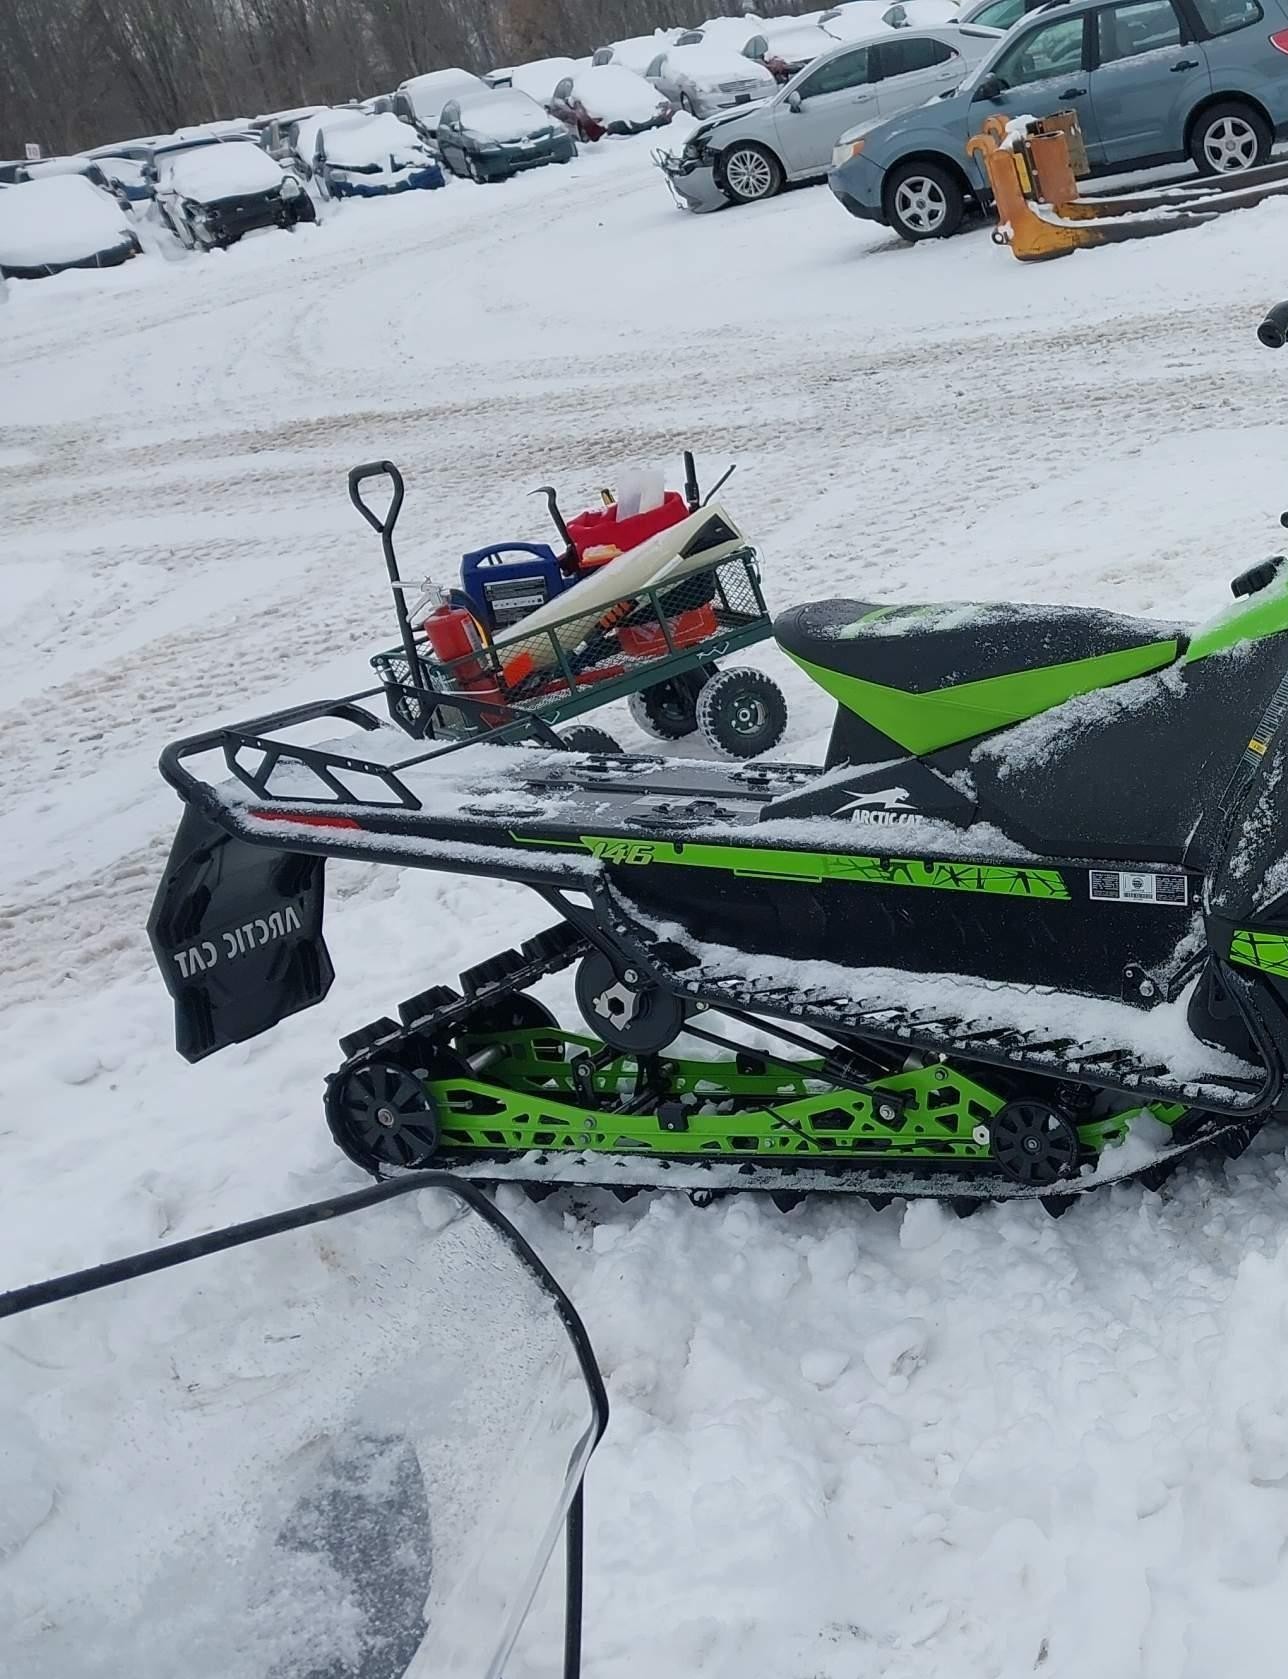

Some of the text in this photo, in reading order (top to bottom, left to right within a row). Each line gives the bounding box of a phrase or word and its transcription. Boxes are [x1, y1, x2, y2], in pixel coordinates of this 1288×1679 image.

[851, 808, 924, 826] ARCTIC CAT
[591, 841, 655, 865] 146
